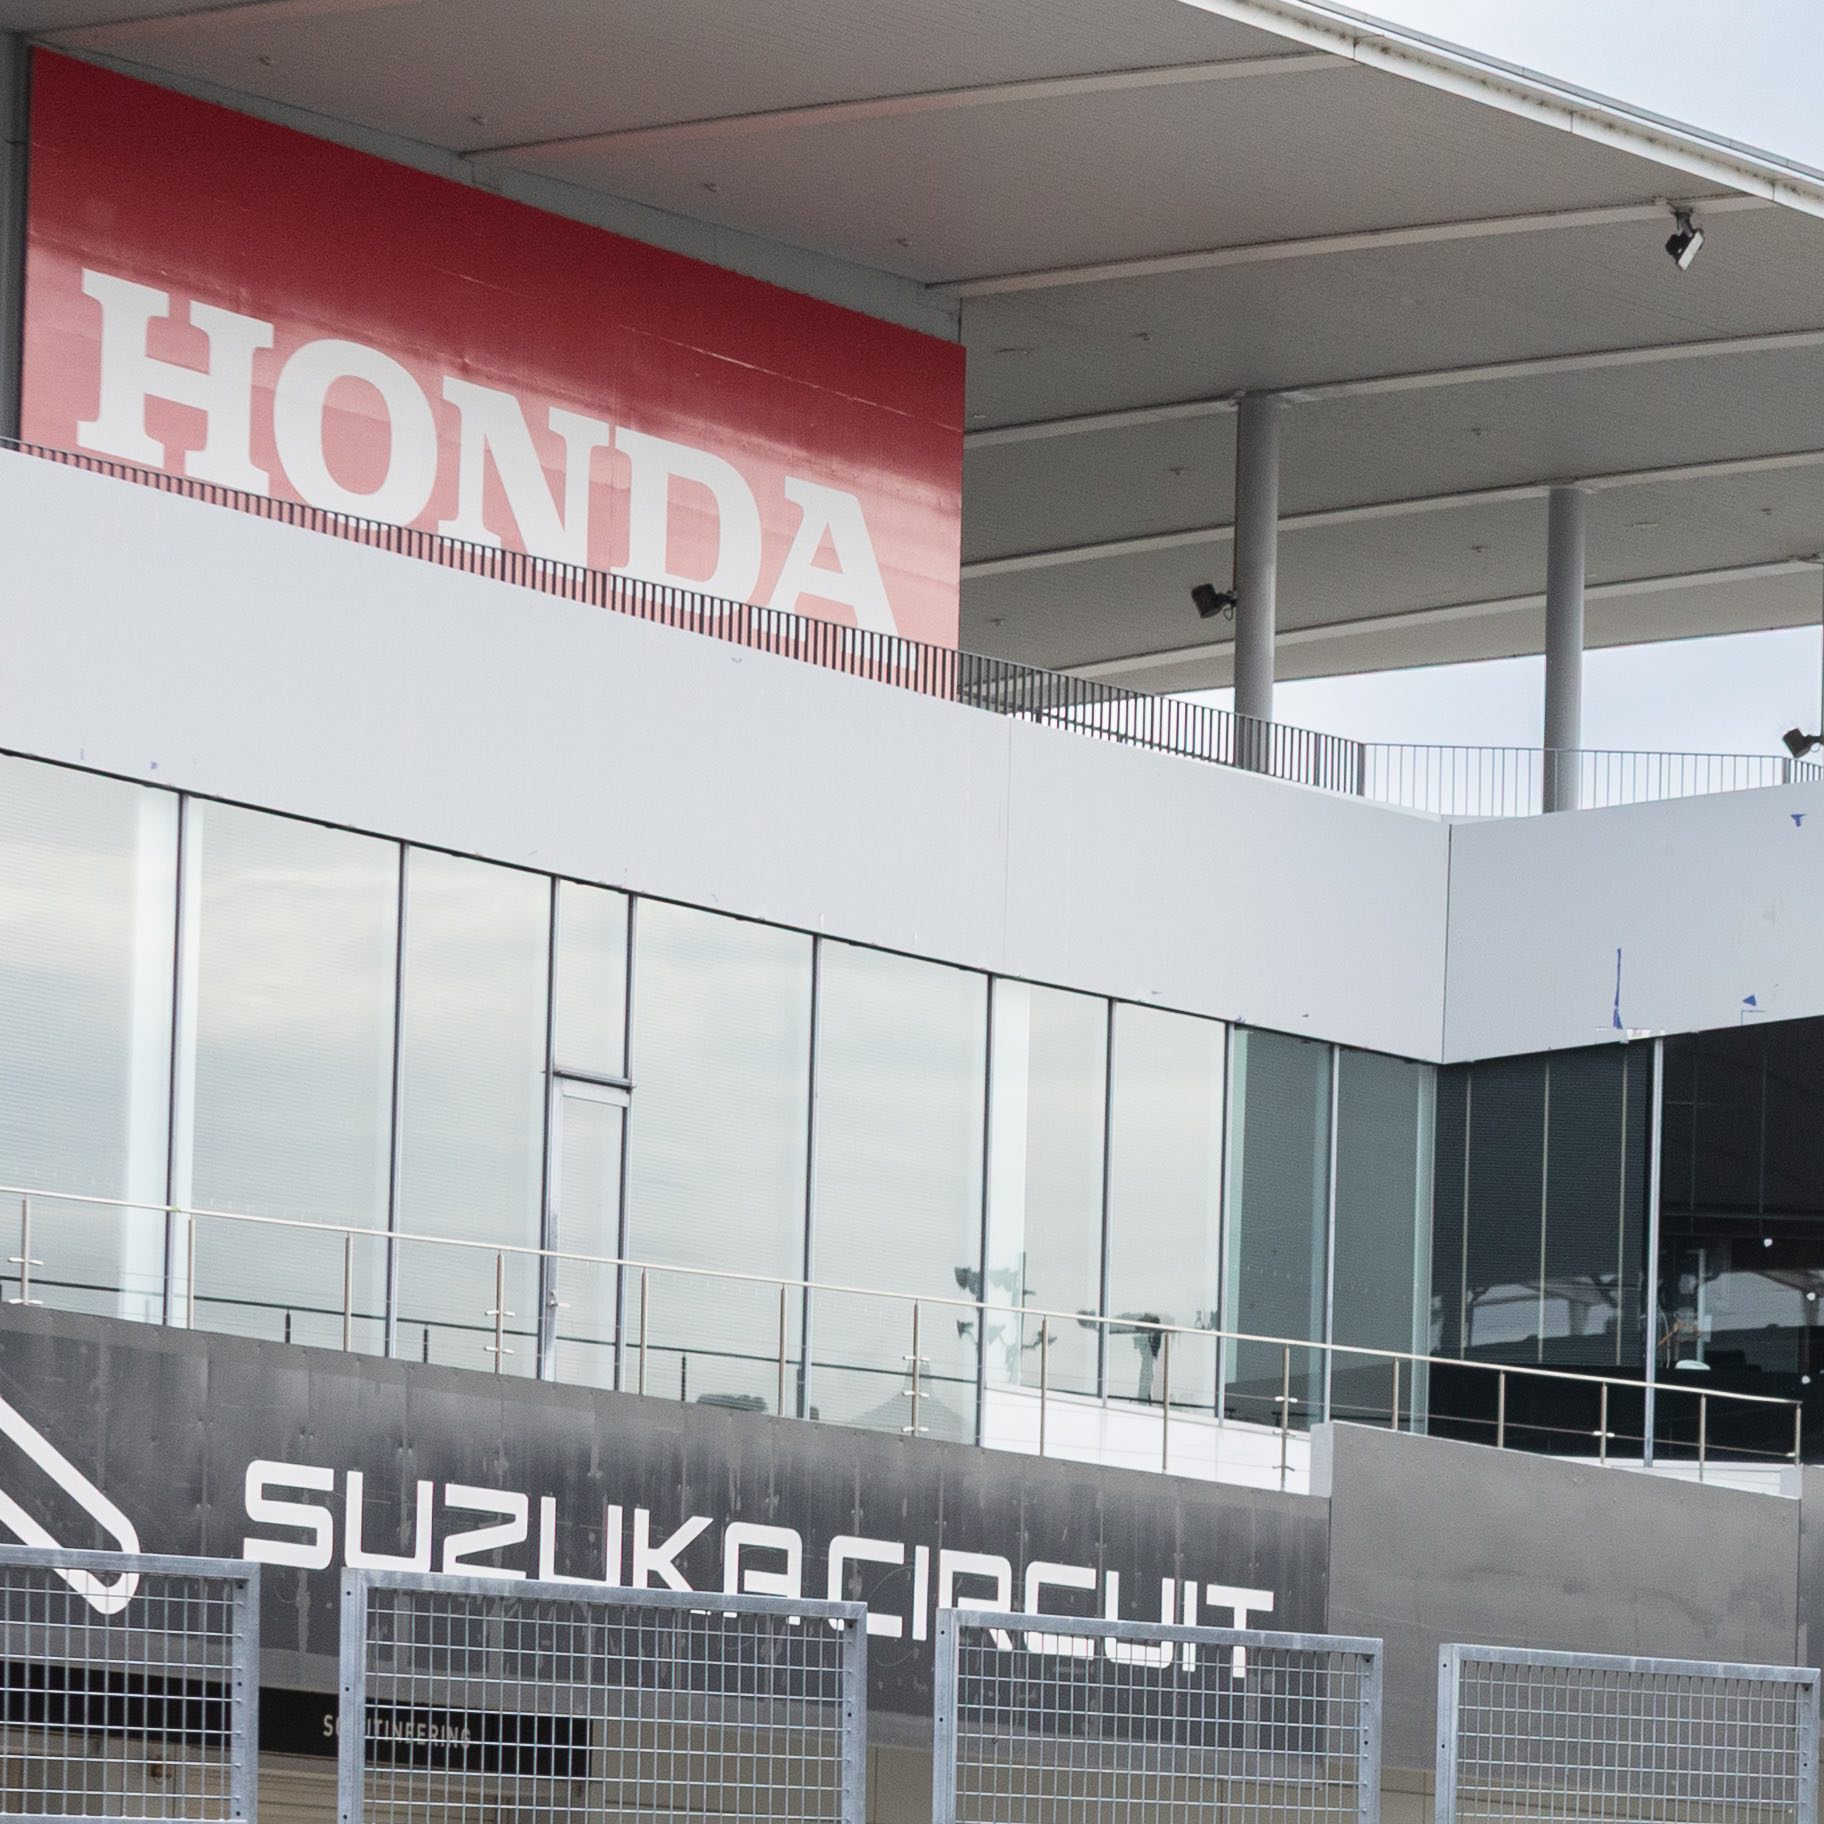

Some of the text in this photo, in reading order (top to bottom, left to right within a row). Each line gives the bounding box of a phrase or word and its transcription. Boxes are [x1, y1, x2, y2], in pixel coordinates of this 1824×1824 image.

[76, 267, 920, 672] HONDA
[243, 1459, 802, 1626] SUZUKA
[322, 1714, 472, 1750] STINEERING
